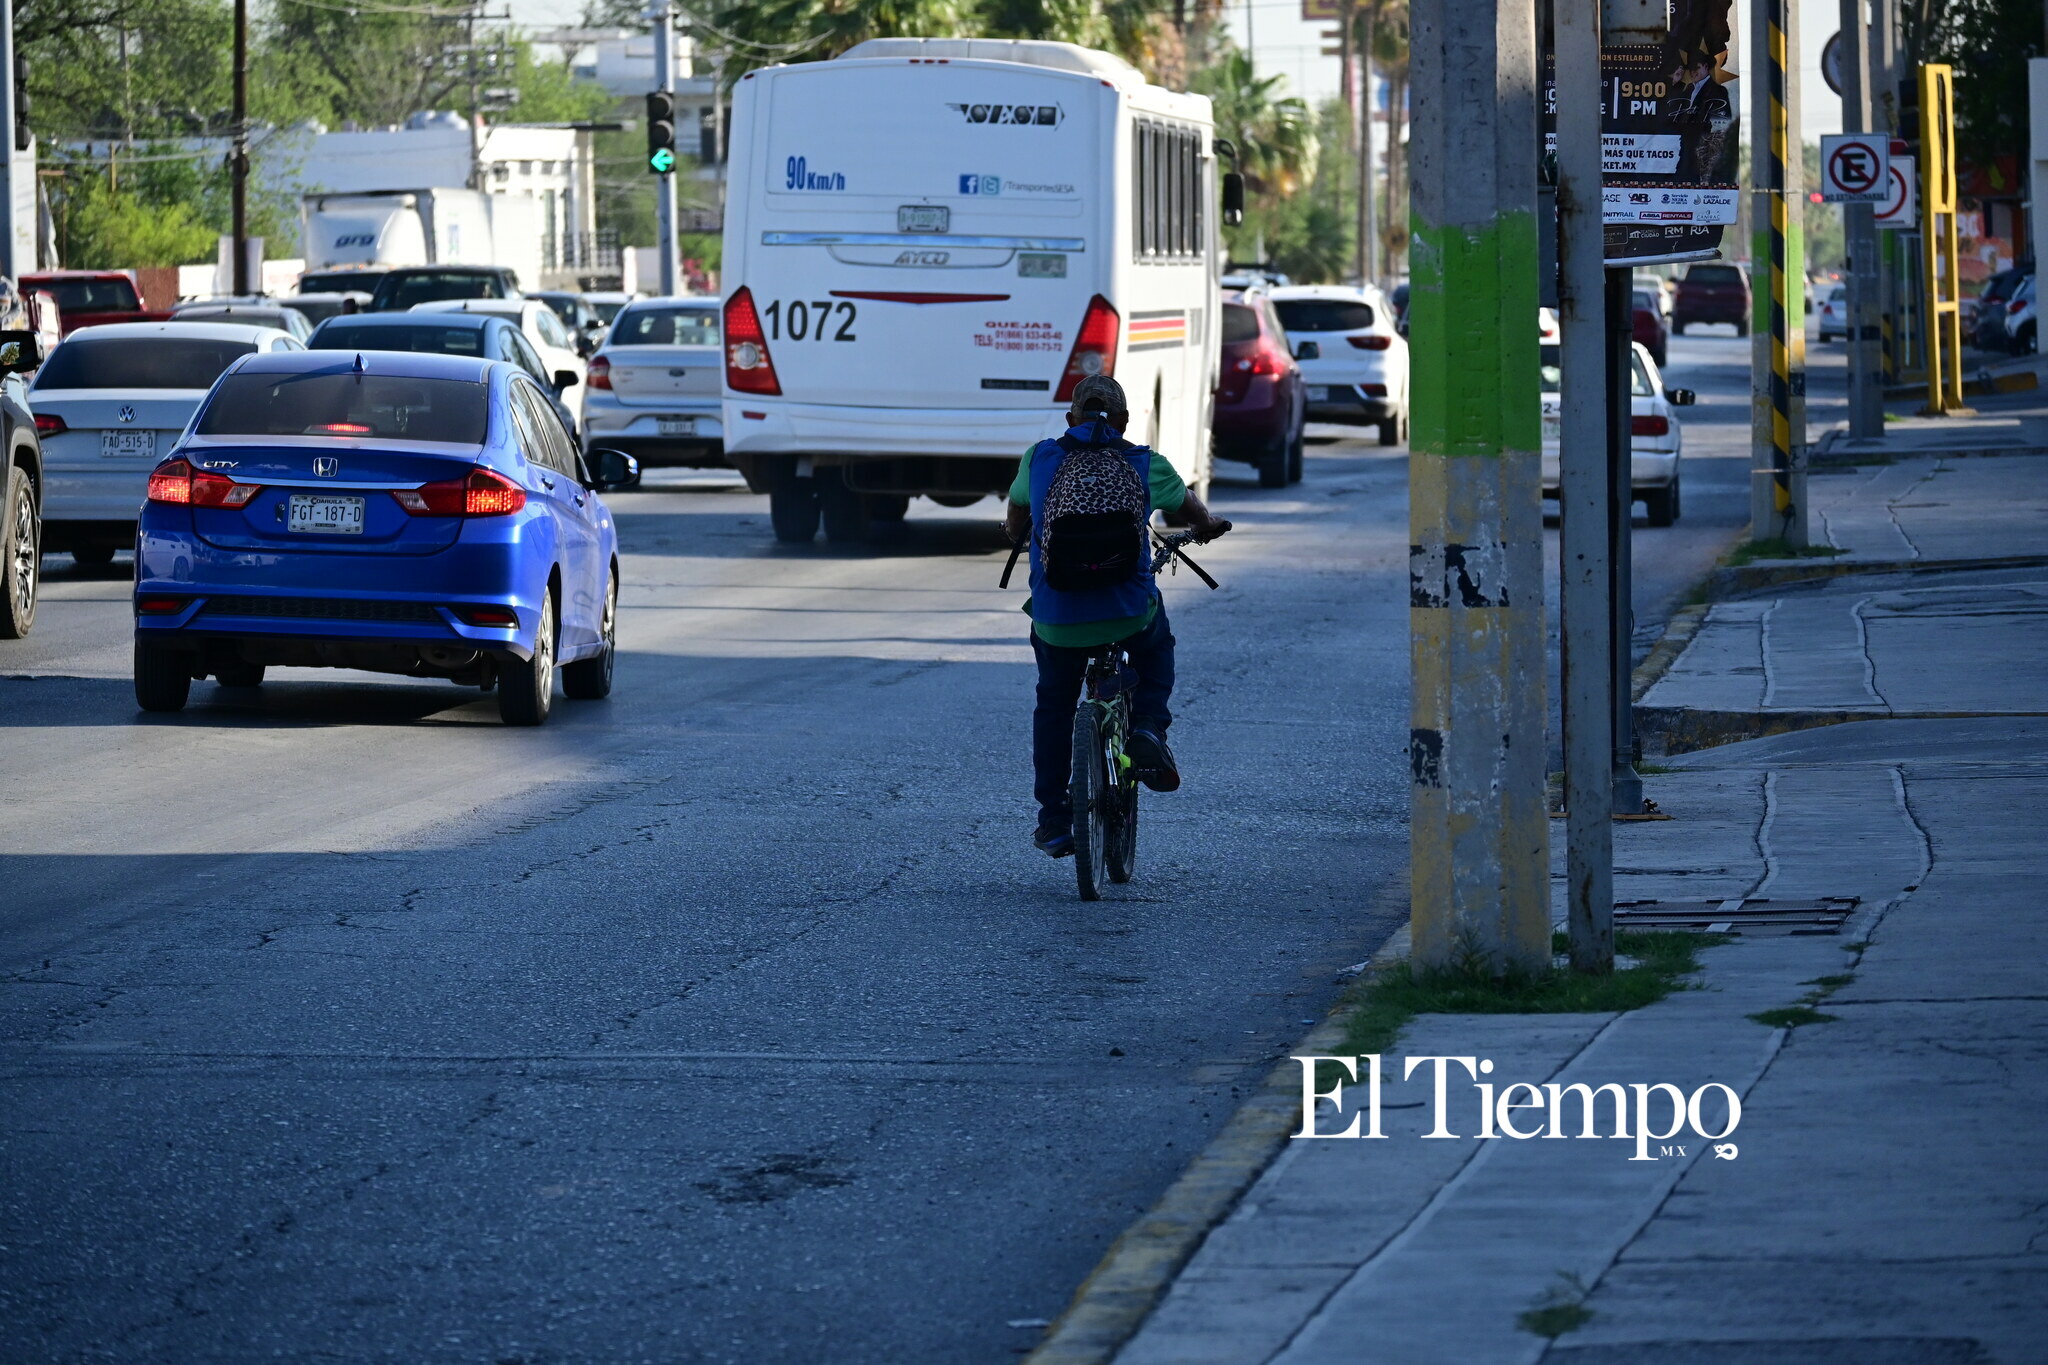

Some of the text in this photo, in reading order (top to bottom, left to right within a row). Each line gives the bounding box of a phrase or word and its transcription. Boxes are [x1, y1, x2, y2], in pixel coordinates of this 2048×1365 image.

[1613, 54, 1643, 62] ESTELAR
[1621, 81, 1666, 98] 9:00
[1630, 100, 1657, 116] PM
[1622, 138, 1635, 146] EN
[1604, 147, 1674, 159] MÁS QUE TACOS
[1601, 162, 1637, 170] KET.MX
[786, 155, 846, 191] 90 Km/h
[764, 299, 857, 342] 1072
[985, 321, 1052, 330] QUEJAS
[103, 435, 154, 449] FAD-515-D
[203, 460, 240, 469] CITY
[291, 504, 361, 522] FGT-187-D
